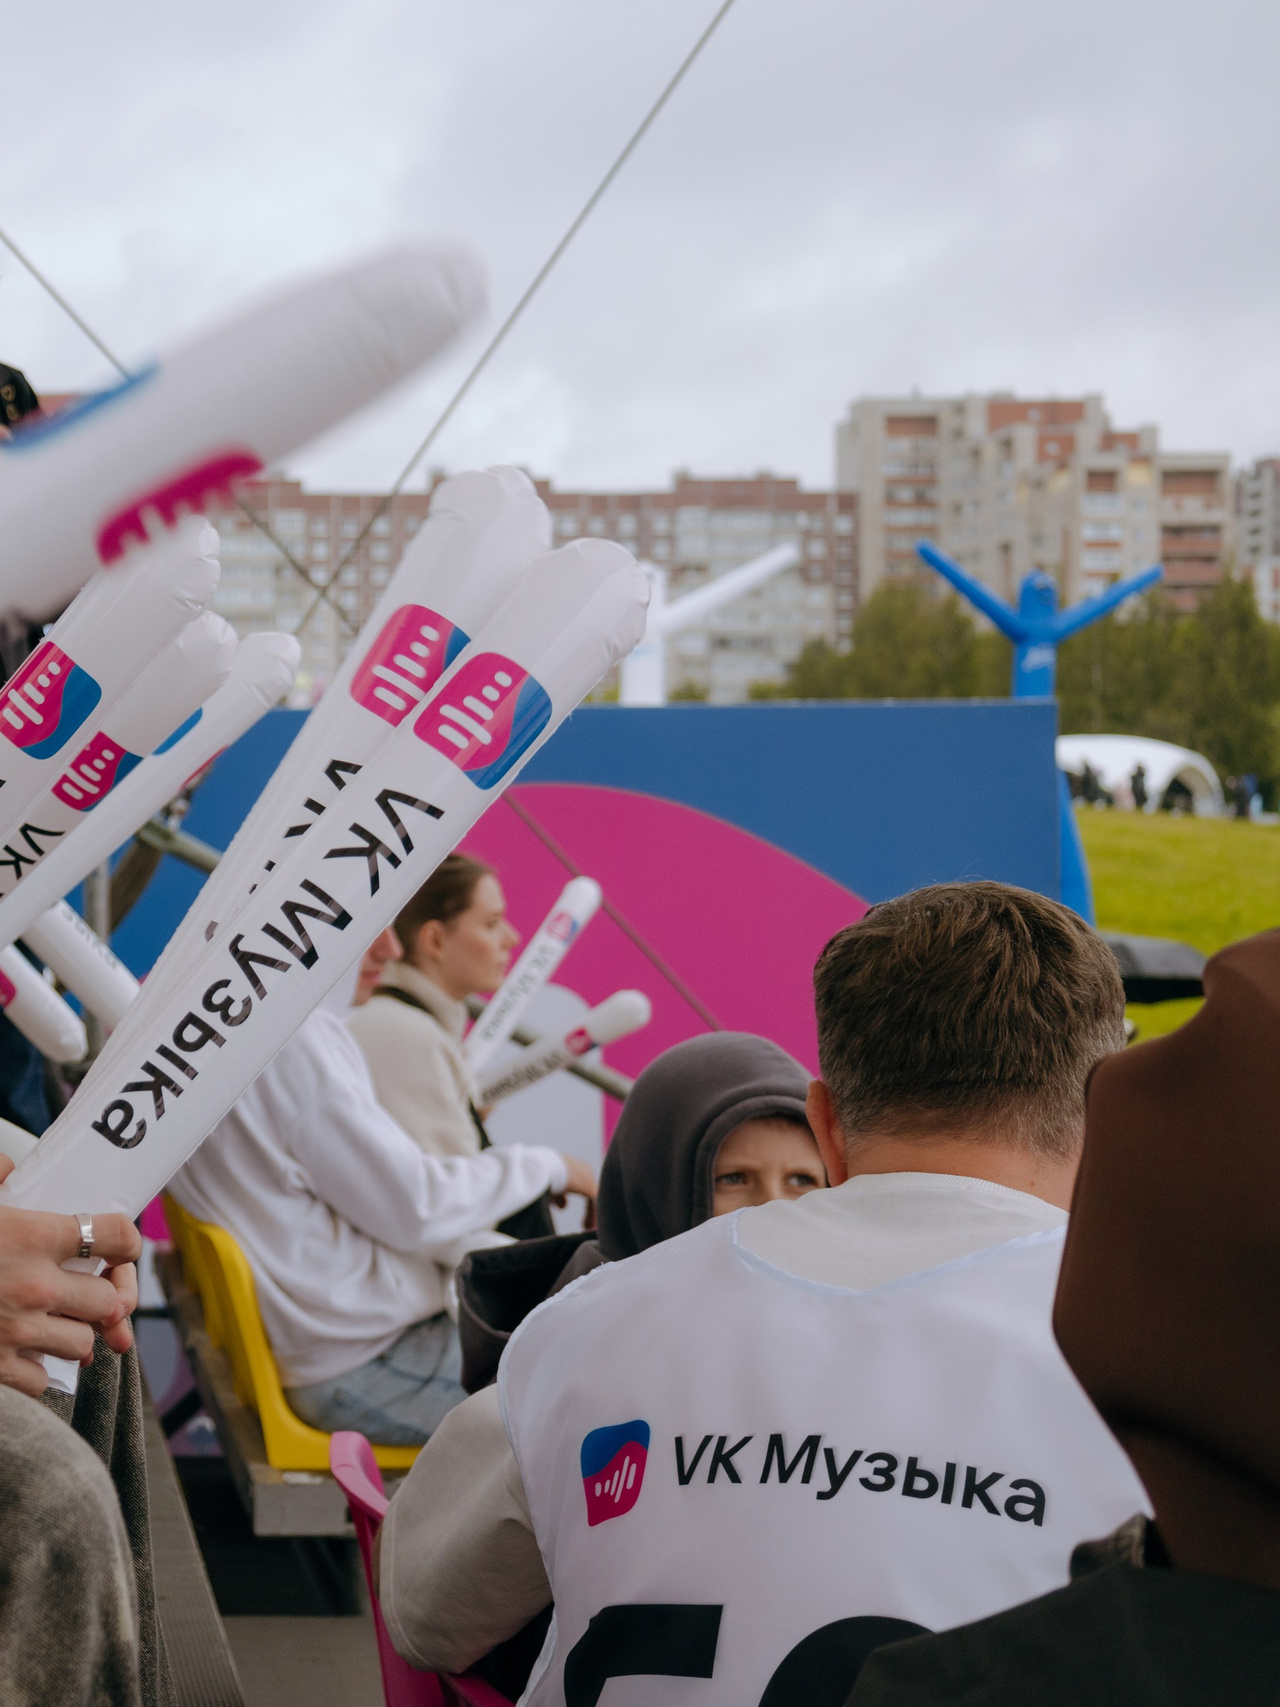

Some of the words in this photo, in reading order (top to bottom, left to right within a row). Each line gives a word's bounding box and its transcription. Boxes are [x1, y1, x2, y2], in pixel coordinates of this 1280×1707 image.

[323, 788, 445, 898] VK
[91, 879, 353, 1149] Музыка
[674, 1434, 754, 1486] VK
[759, 1433, 1046, 1527] Музыка
